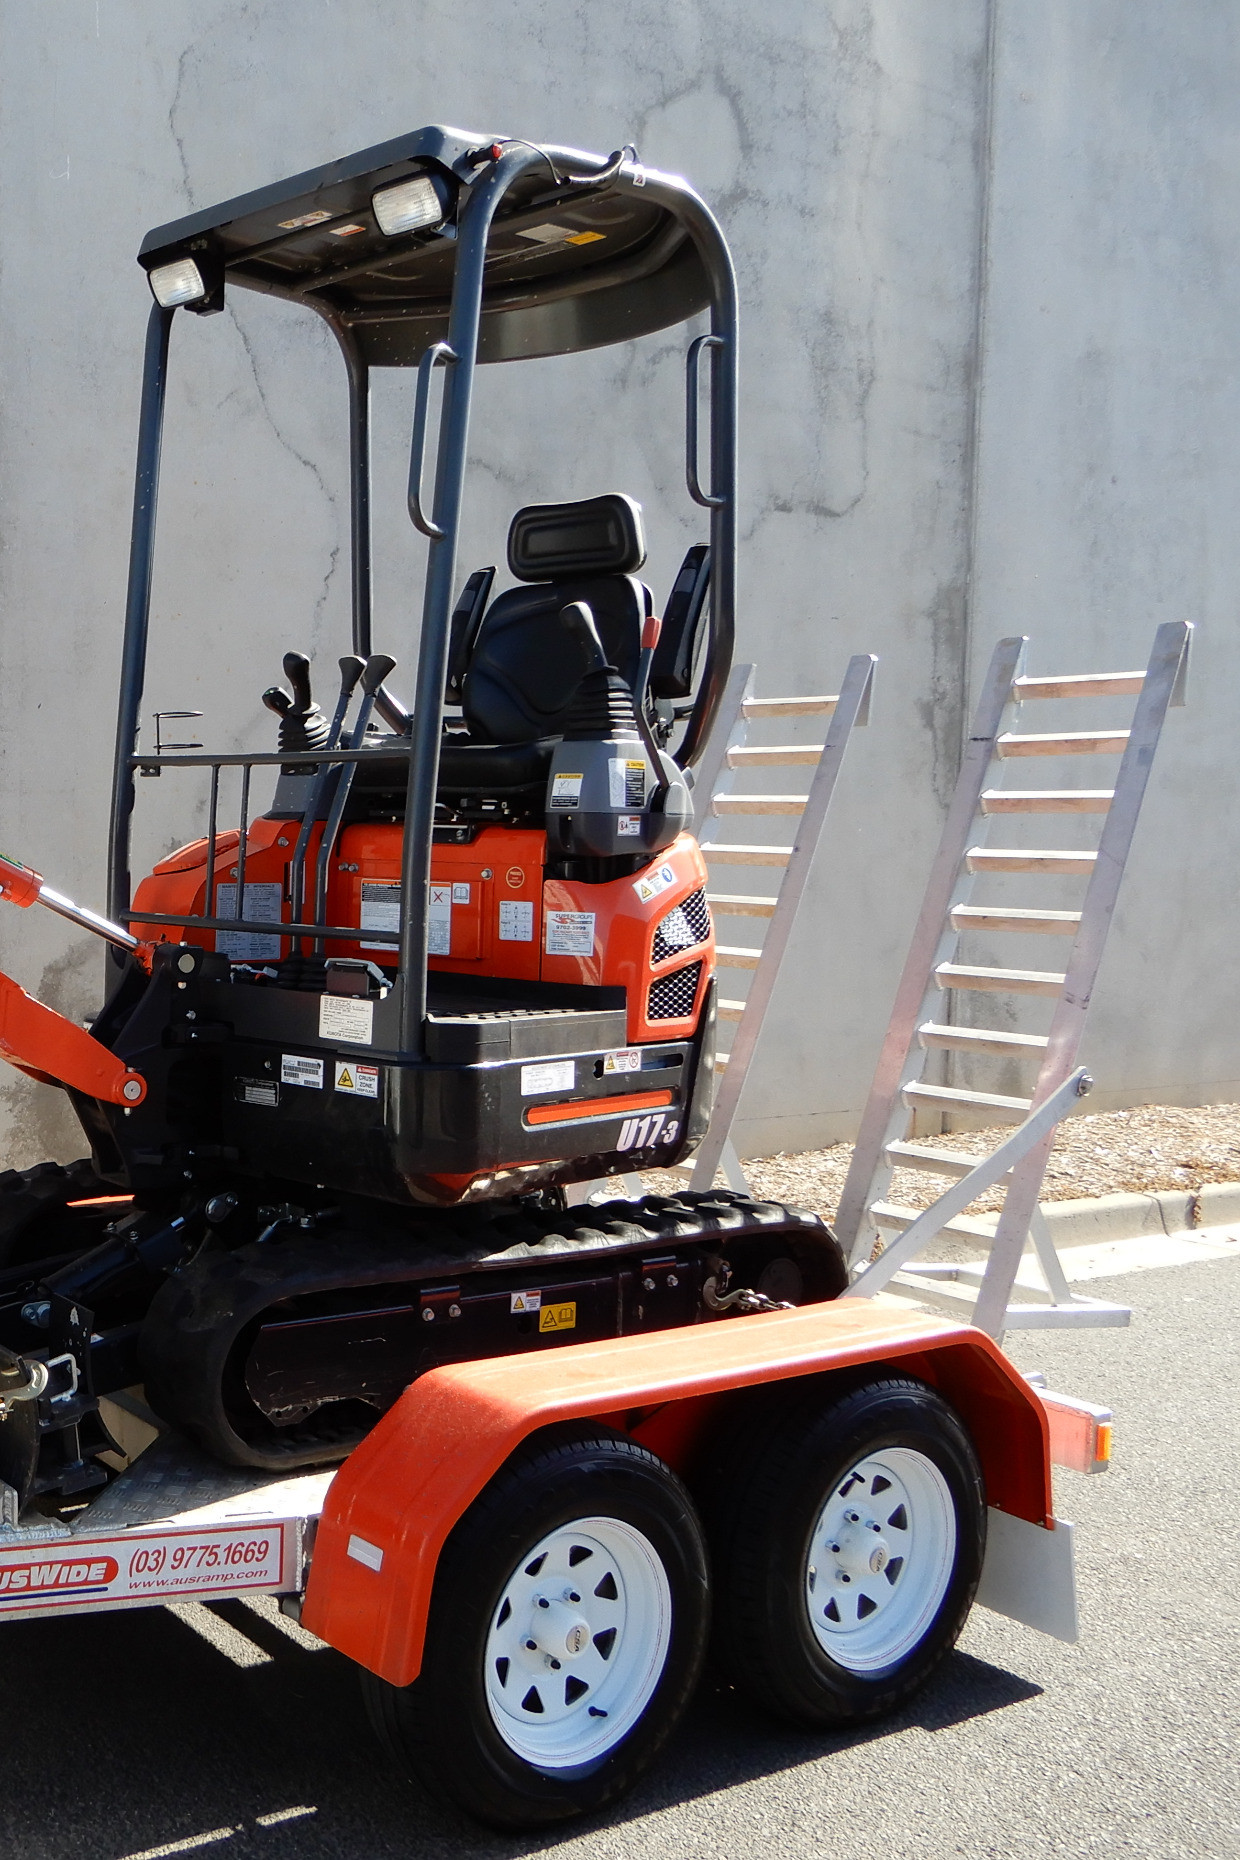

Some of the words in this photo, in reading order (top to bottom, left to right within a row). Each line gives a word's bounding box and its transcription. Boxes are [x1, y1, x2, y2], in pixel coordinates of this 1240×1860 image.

[616, 1113, 679, 1152] U17-3
[128, 1545, 167, 1578] (03)
[170, 1539, 270, 1571] 9775.1669
[128, 1569, 268, 1590] www.ausramp.com
